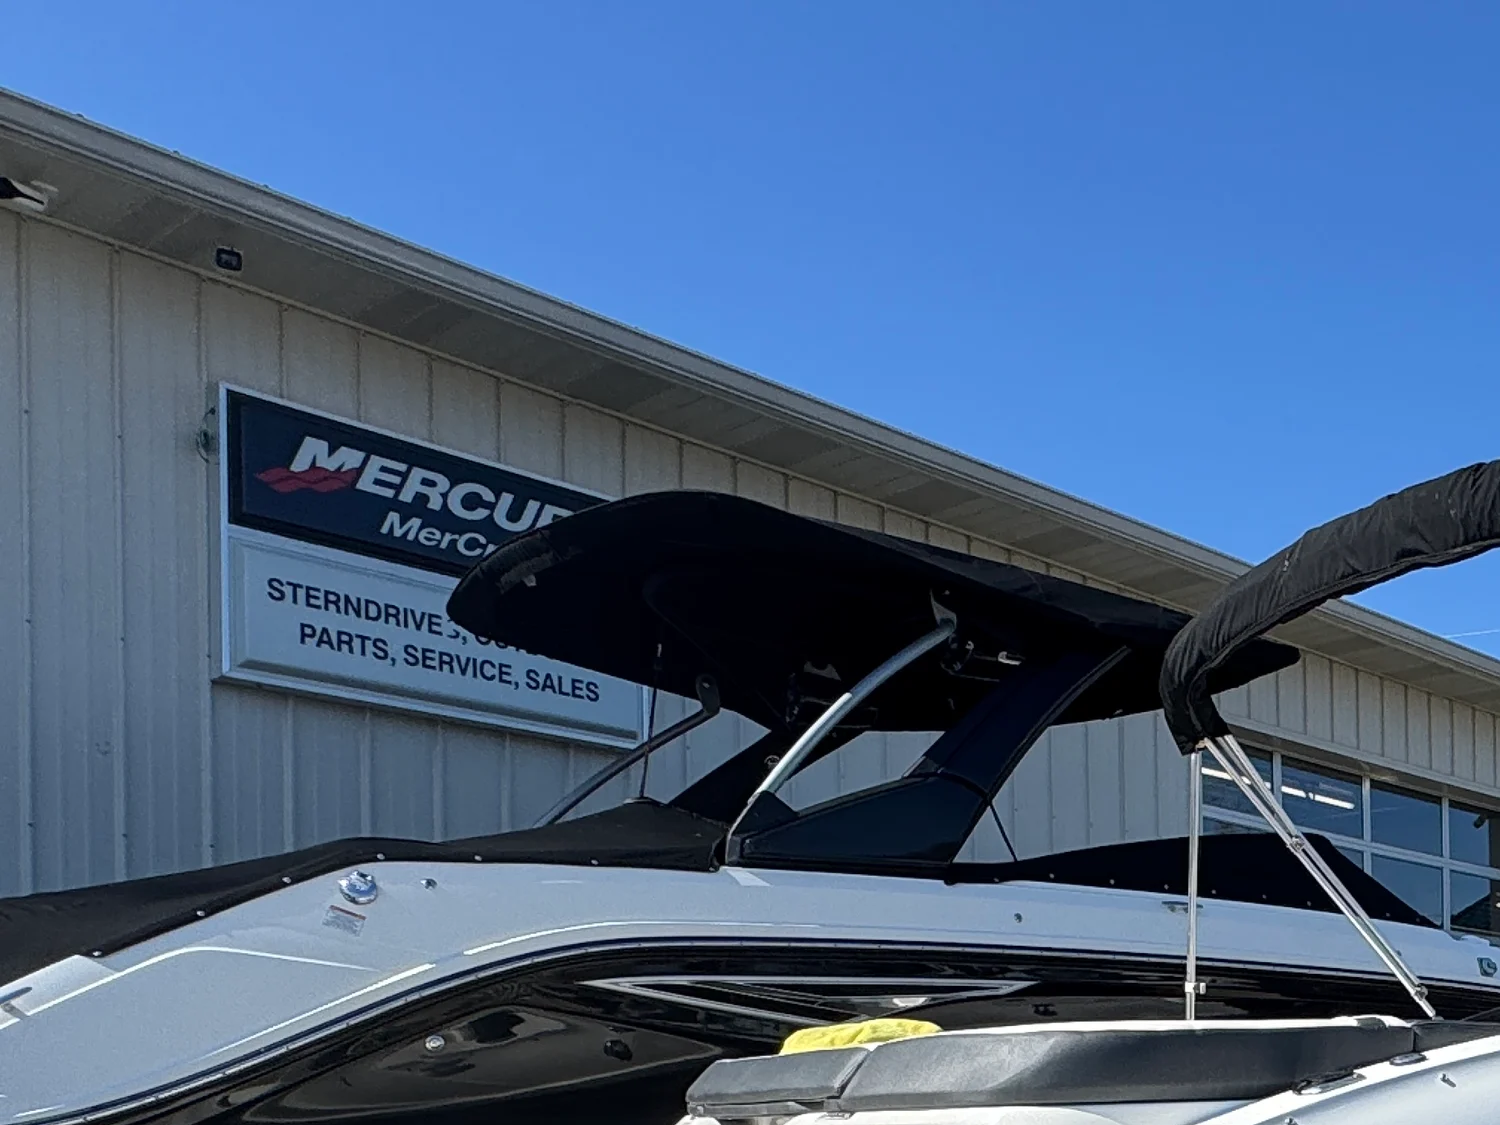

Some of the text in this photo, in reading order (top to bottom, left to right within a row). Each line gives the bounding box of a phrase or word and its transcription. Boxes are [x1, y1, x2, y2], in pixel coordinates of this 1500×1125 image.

[300, 622, 600, 702] PARTS, SERVICE, SALES
